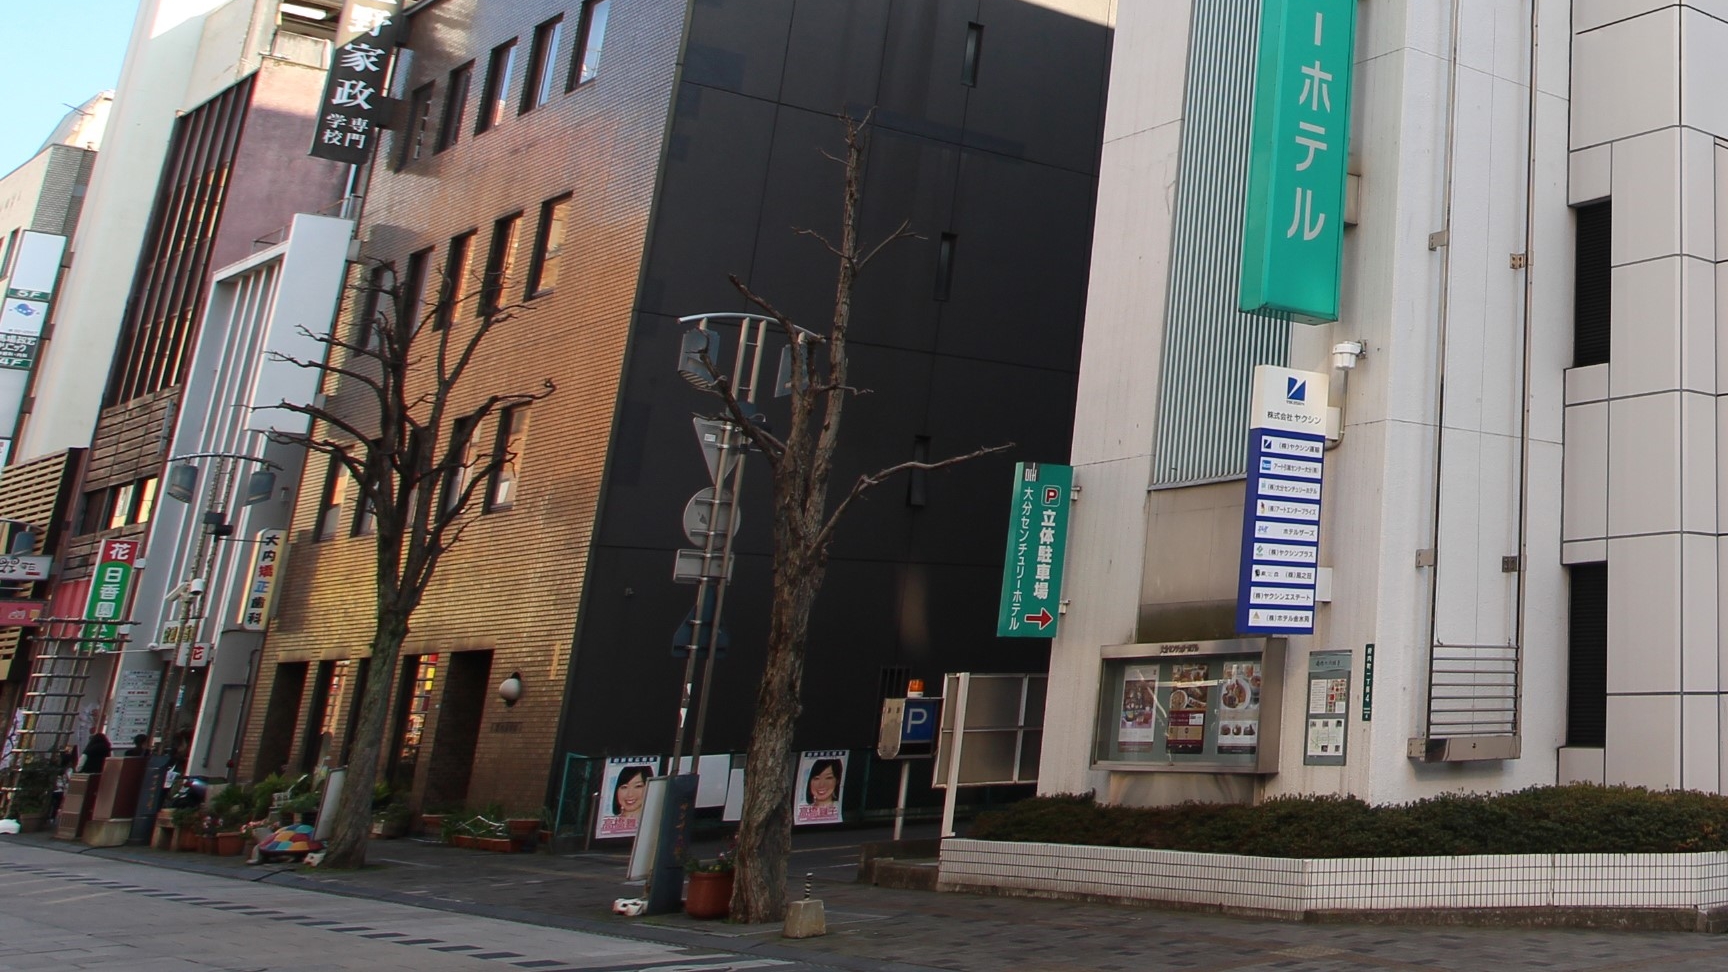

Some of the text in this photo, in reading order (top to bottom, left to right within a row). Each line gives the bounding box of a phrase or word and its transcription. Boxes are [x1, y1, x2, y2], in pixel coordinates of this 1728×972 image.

[1267, 410, 1322, 425] 株式会社 ヤクシン
[109, 542, 131, 560] 花
[1008, 487, 1034, 631] 大分センチュリーホテル
[1033, 509, 1056, 600] 立体駐車場
[907, 708, 928, 734] P
